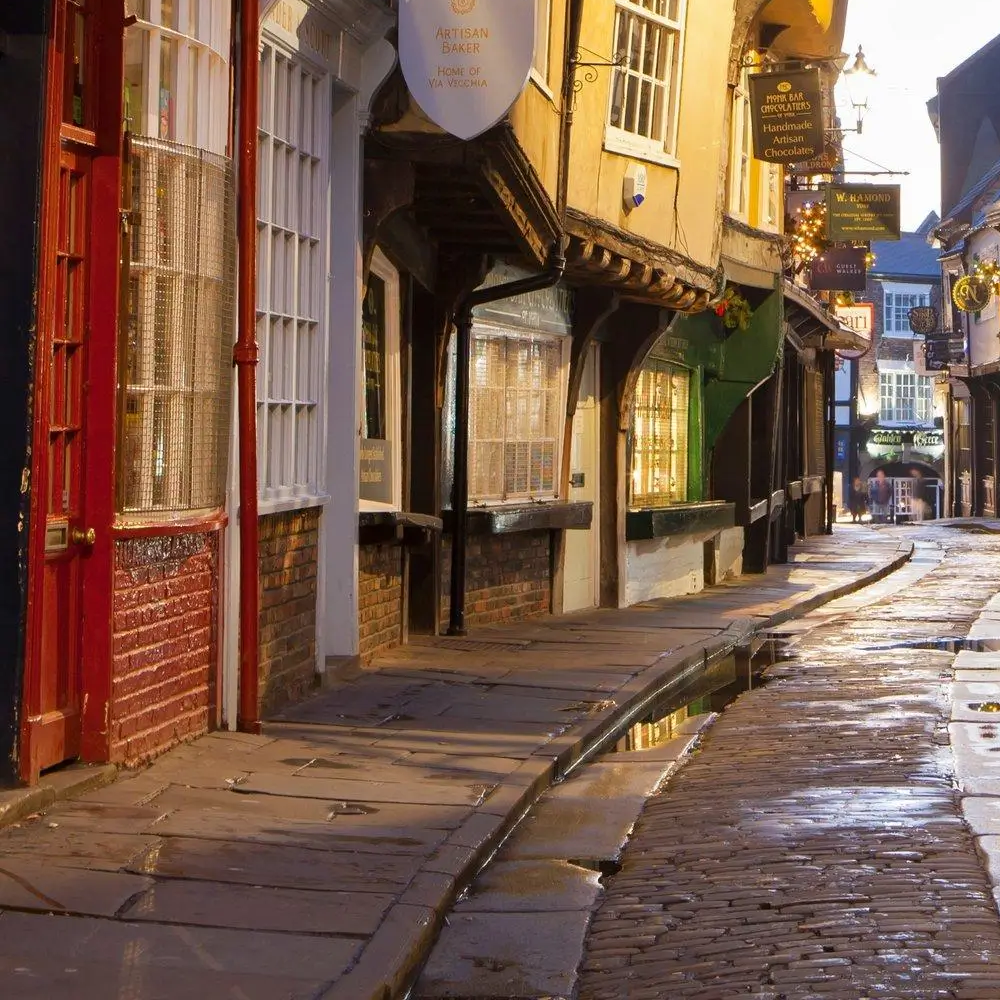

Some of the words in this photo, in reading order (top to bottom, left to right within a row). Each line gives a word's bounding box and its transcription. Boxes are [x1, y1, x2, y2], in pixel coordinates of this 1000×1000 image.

[435, 27, 489, 40] ARTISAN
[441, 42, 480, 54] BAKER
[437, 66, 464, 76] HOME
[469, 66, 481, 76] OF
[428, 79, 443, 88] VIA
[447, 78, 488, 88] VECCHIA
[766, 93, 787, 104] MONK
[789, 91, 804, 102] BAR
[760, 101, 811, 114] CHOCOLATIERS
[763, 121, 813, 133] Handmade
[773, 134, 804, 145] Artisan
[764, 146, 815, 158] Chocolates
[836, 192, 847, 202] W.
[850, 193, 891, 202] HAMOND
